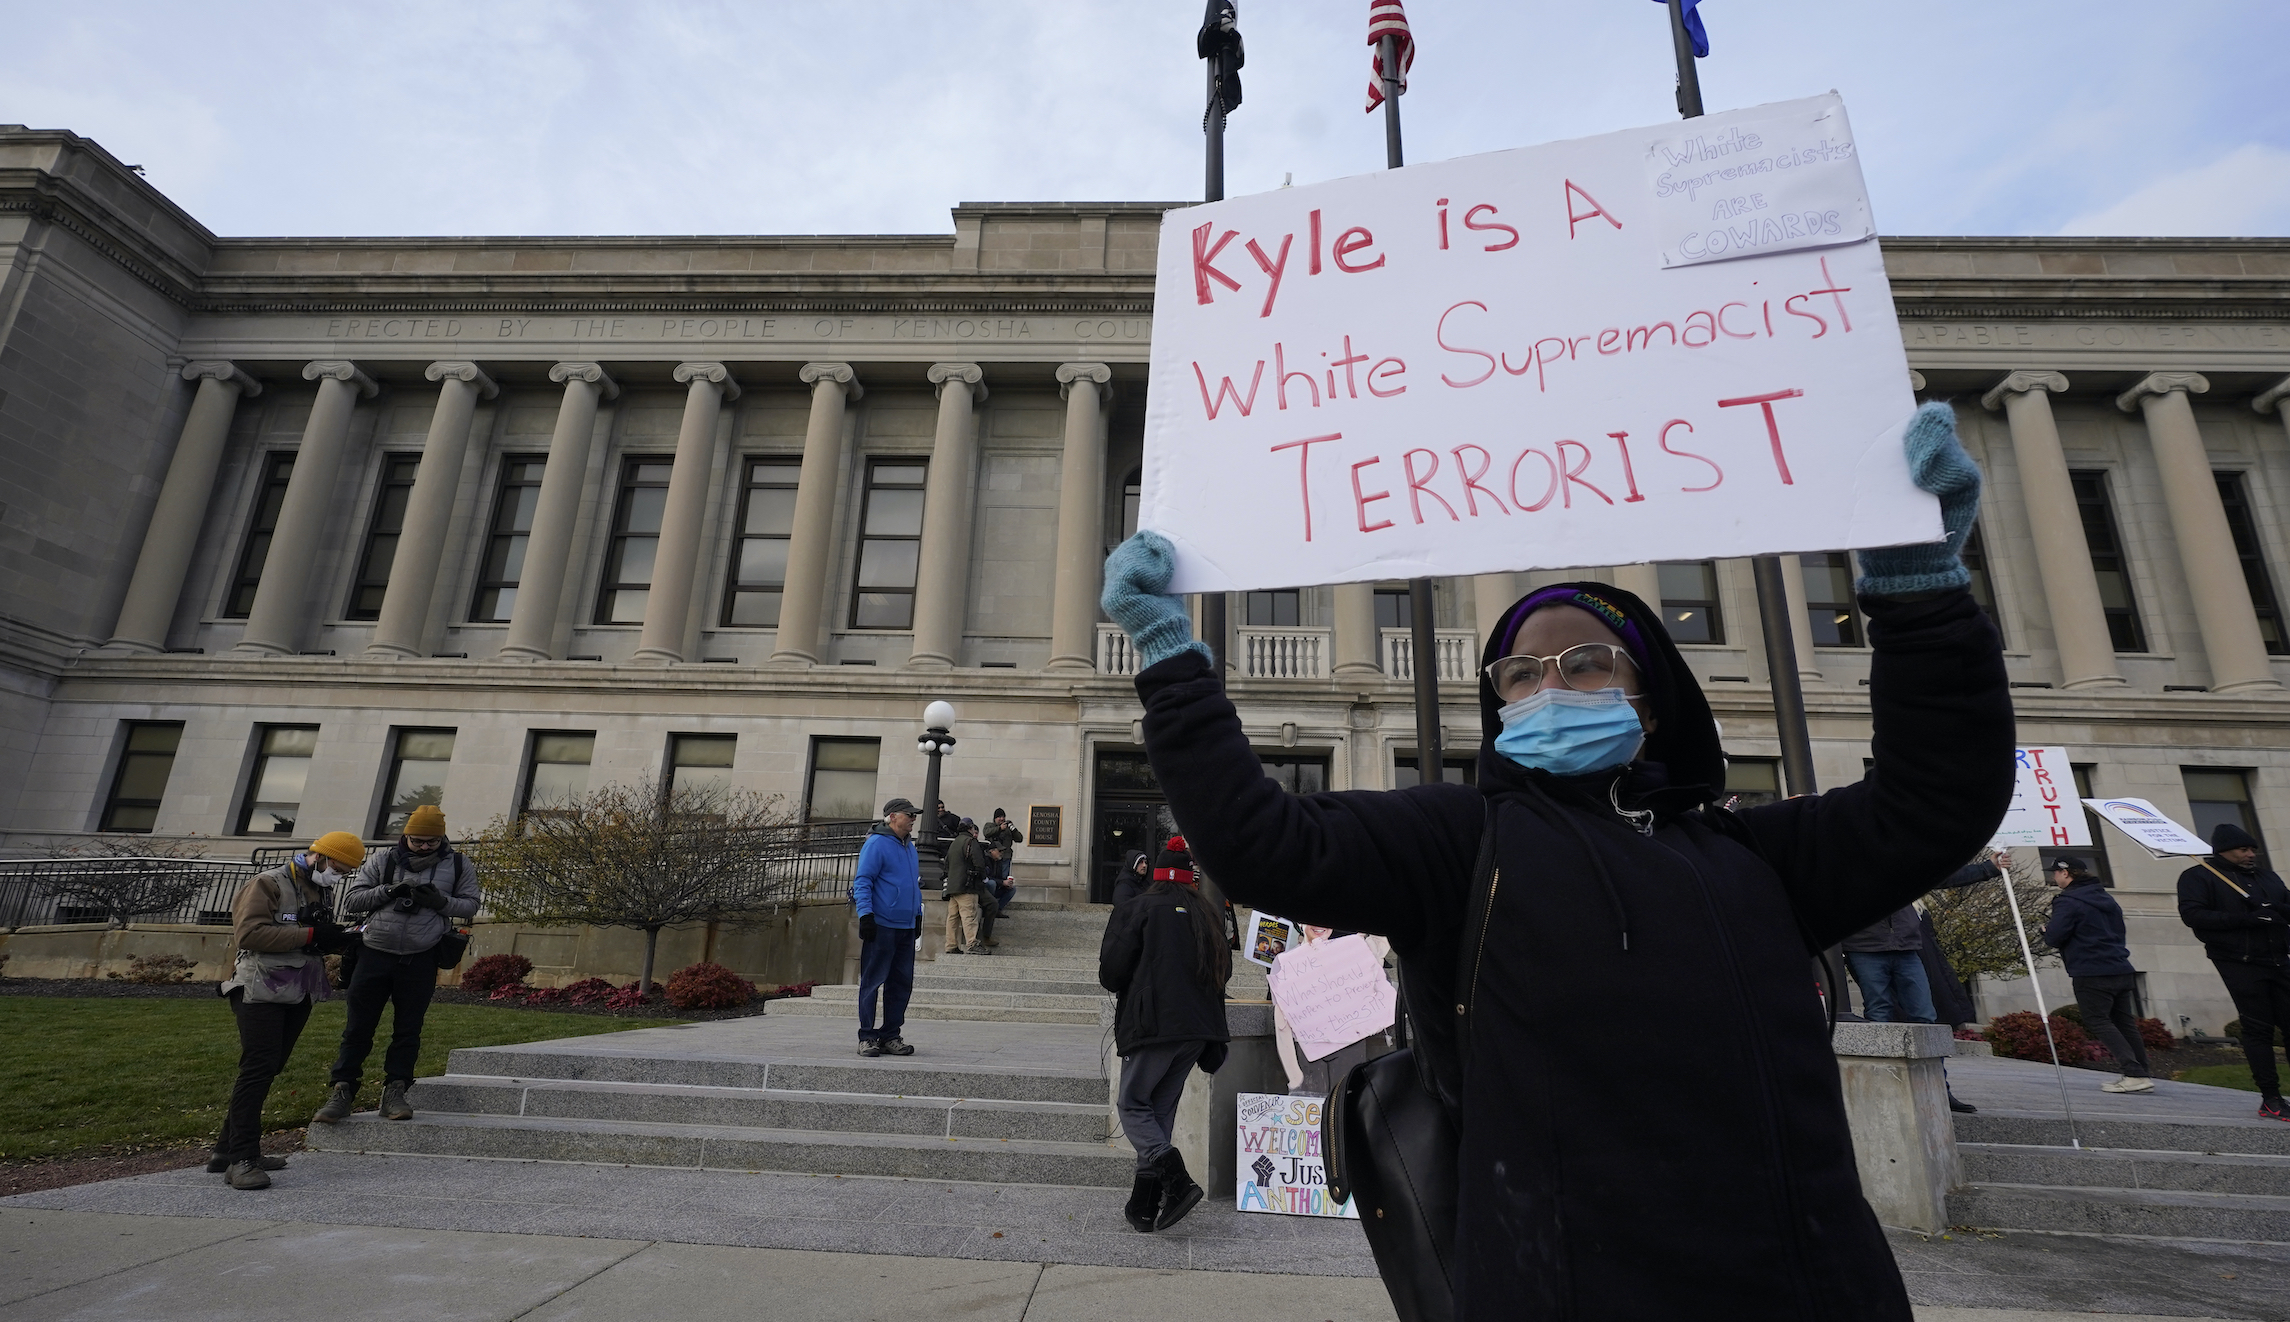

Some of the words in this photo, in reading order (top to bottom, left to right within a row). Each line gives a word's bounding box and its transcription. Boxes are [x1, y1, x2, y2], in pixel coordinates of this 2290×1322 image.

[1661, 127, 1763, 167] White
[1712, 193, 1769, 221] ARE
[1191, 207, 1387, 318] Kyle
[1437, 197, 1521, 253] is
[1563, 177, 1624, 241] A
[1679, 210, 1843, 260] COWARDS
[326, 319, 463, 338] ERECTED
[498, 319, 532, 338] BY
[569, 319, 626, 338] THE
[660, 319, 777, 338] PEOPLE
[813, 319, 855, 338] OF
[892, 319, 1032, 339] KENOSHA
[1899, 325, 2034, 346] APABLE
[1191, 334, 1409, 421] White
[1436, 255, 1853, 393] Supremacist
[1269, 387, 1805, 543] TERRORIST
[282, 913, 297, 921] PRE
[1324, 993, 1341, 1006] to
[1239, 1125, 1323, 1157] WELCOM
